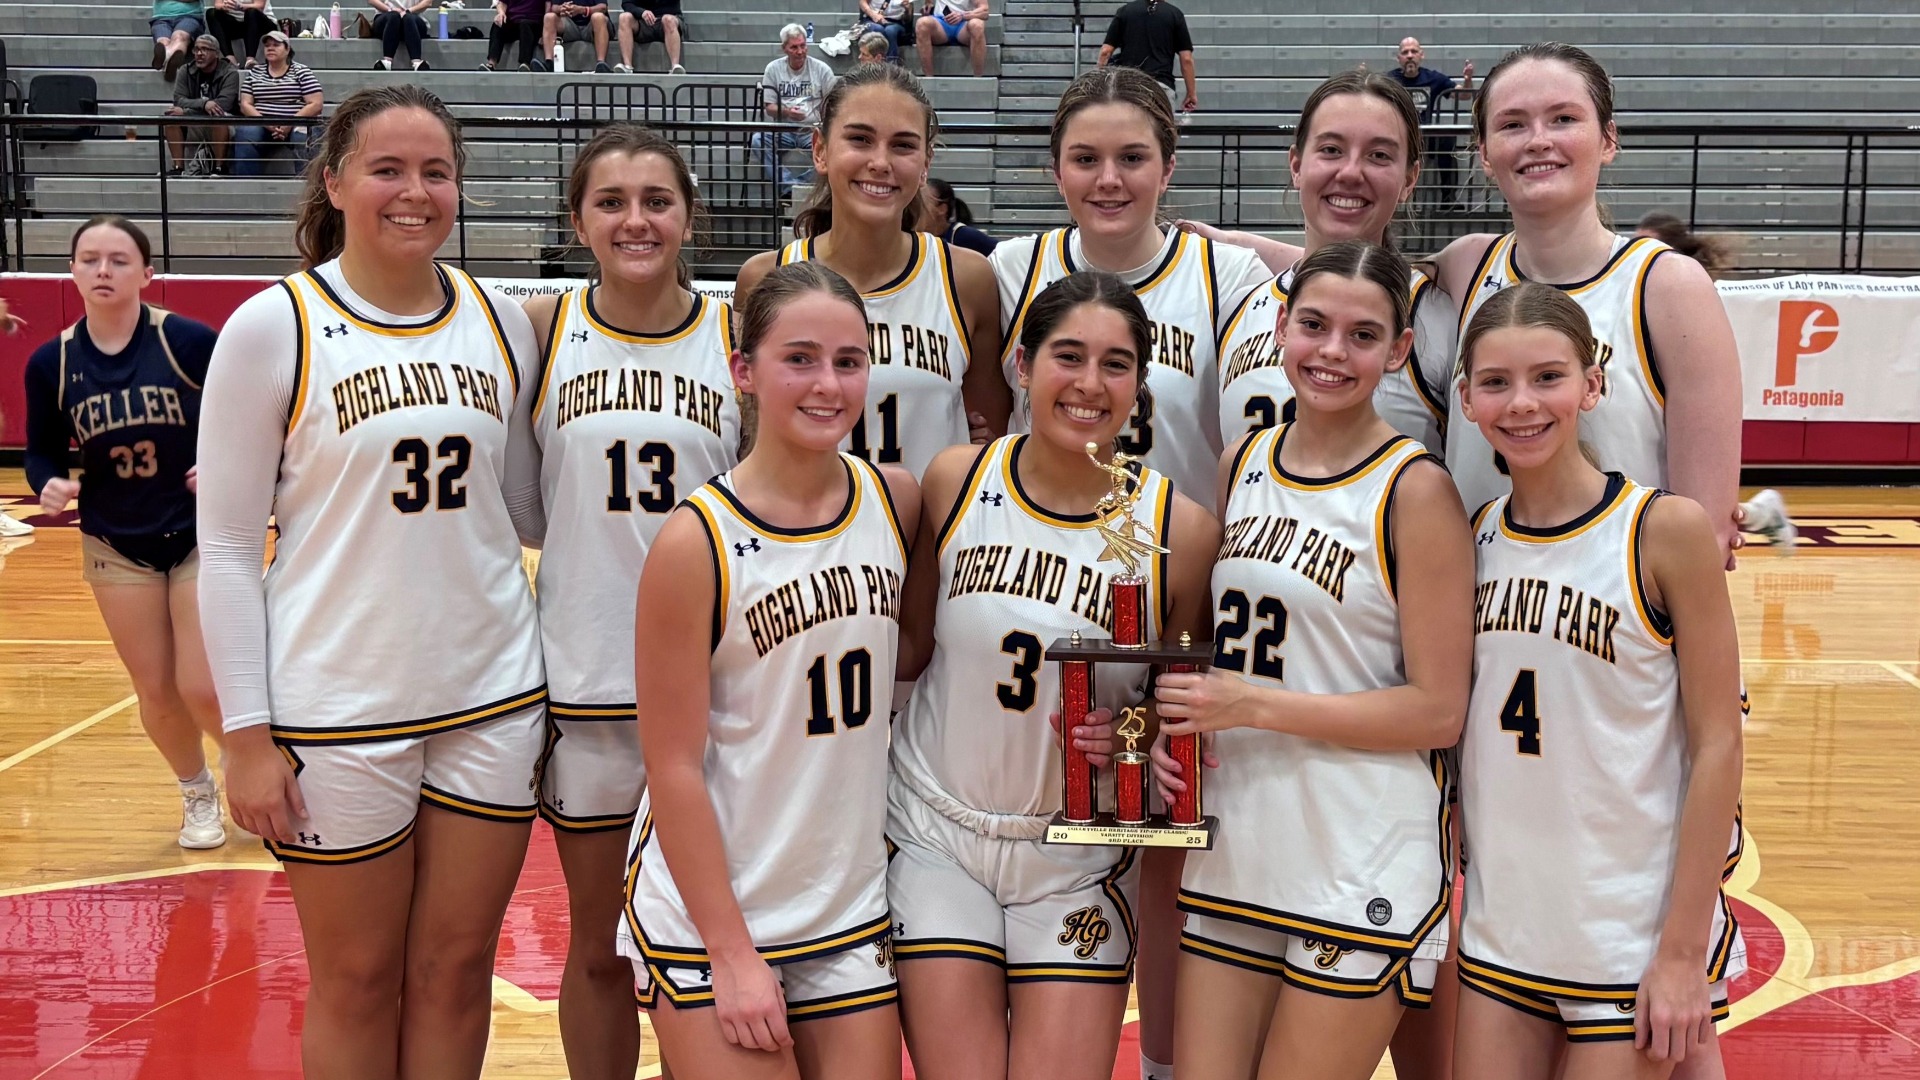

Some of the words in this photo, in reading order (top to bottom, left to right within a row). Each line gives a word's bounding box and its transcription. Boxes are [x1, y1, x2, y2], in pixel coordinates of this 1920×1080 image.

[1788, 281, 1814, 290] LADY
[901, 324, 952, 382] PARK
[1222, 331, 1285, 394] HIGHLA
[70, 386, 186, 445] KELLER
[332, 362, 449, 437] HIGHLAND
[450, 362, 504, 425] PARK
[557, 368, 664, 431] HIGHLAND
[674, 374, 724, 439] PARK
[1763, 389, 1844, 407] Patagonia
[109, 440, 158, 479] 33
[391, 433, 474, 516] 32
[605, 438, 677, 515] 13
[948, 545, 1068, 605] HIGHLAND
[1291, 527, 1356, 605] PARK
[745, 565, 858, 659] HIGHLAND
[1213, 587, 1290, 684] 22
[1554, 585, 1621, 665] PARK
[805, 645, 873, 738] 10
[996, 628, 1045, 714] 3
[1116, 706, 1147, 736] 25
[1499, 667, 1542, 757] 4
[1052, 832, 1068, 840] 20
[1186, 836, 1202, 844] 25
